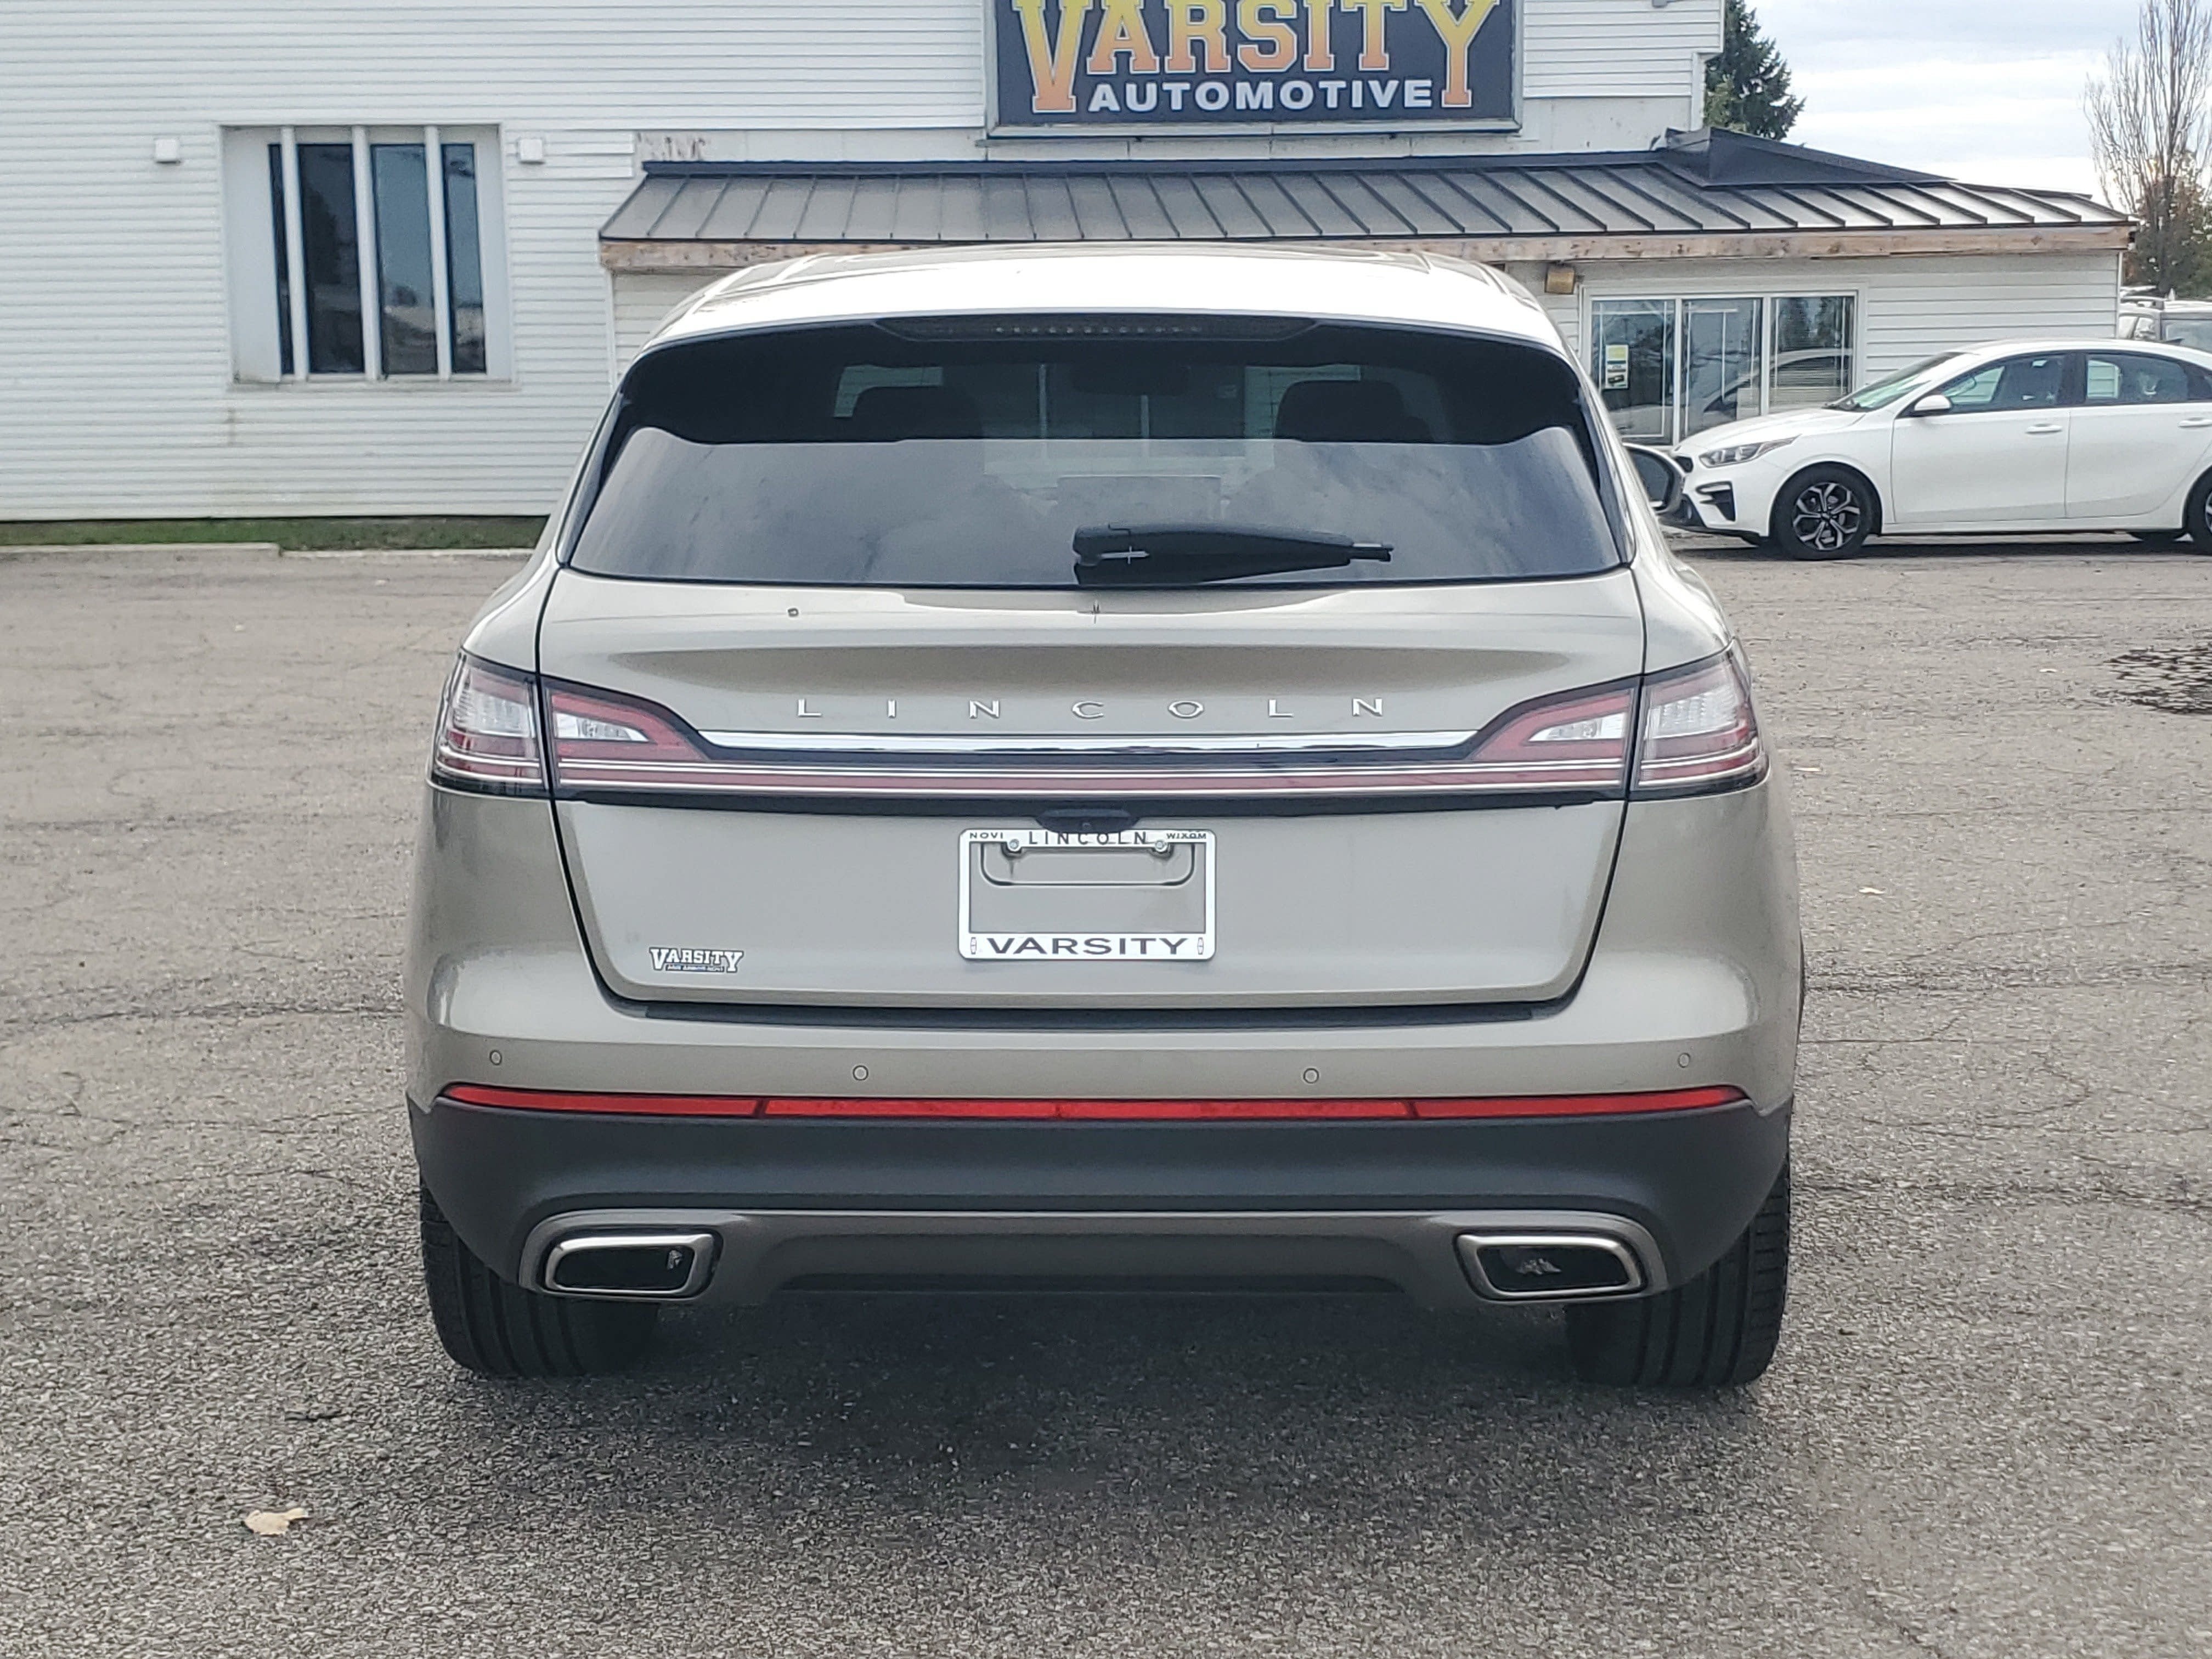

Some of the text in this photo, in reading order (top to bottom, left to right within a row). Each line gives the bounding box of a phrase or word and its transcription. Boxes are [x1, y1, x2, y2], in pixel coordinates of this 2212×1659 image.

[1012, 0, 1499, 112] VARSITY
[1088, 80, 1432, 112] AUTOMOTIVE
[798, 698, 1383, 718] LINCOLN
[1029, 831, 1146, 845] LINCOLN
[986, 937, 1189, 955] VARSITY
[649, 947, 744, 973] VARSITY
